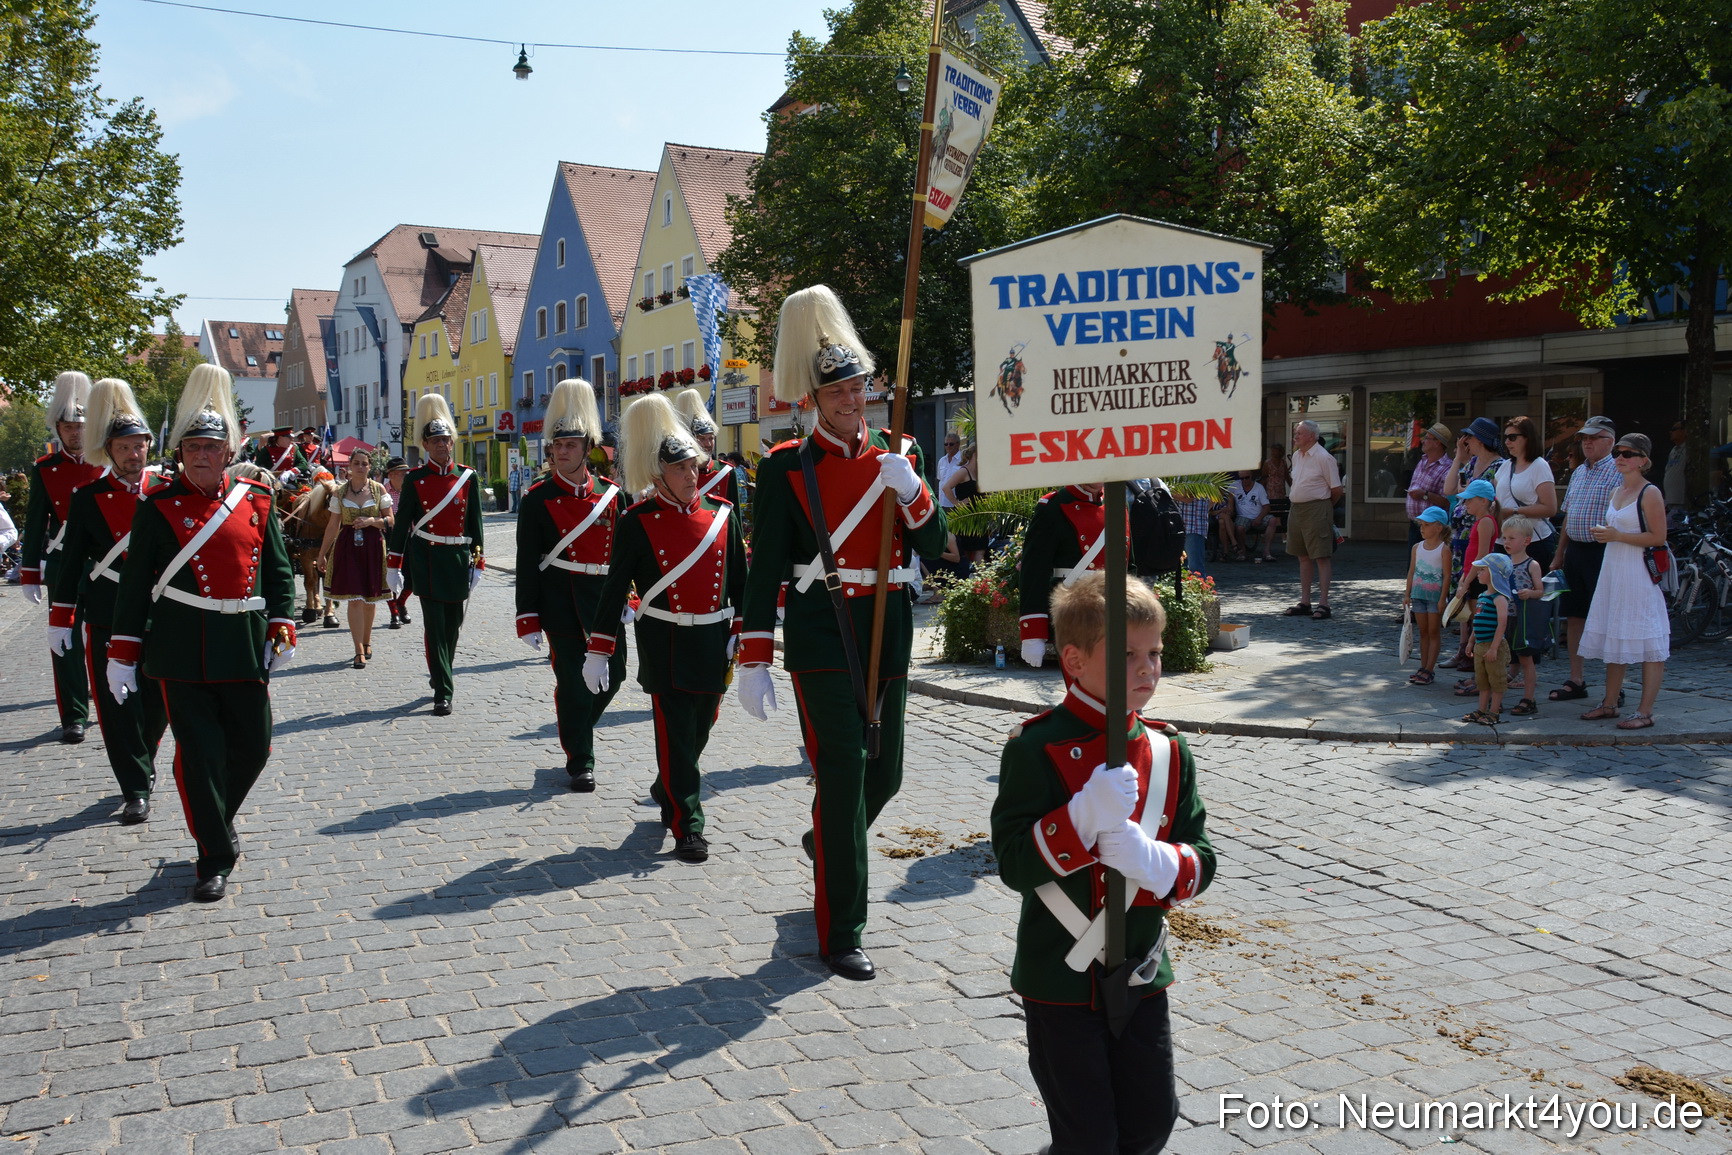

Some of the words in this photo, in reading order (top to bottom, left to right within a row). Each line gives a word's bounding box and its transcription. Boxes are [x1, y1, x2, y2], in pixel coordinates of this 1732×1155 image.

[944, 64, 994, 105] TRADITIONS-
[953, 90, 982, 121] VEREIN
[989, 261, 1255, 310] TRADITIONS-
[1043, 306, 1195, 346] VEREIN
[426, 370, 439, 382] HOTEL
[1052, 359, 1192, 390] NEUMARKTER
[1050, 382, 1198, 415] CHEVAULEGERS
[1008, 417, 1233, 466] ESKADRON
